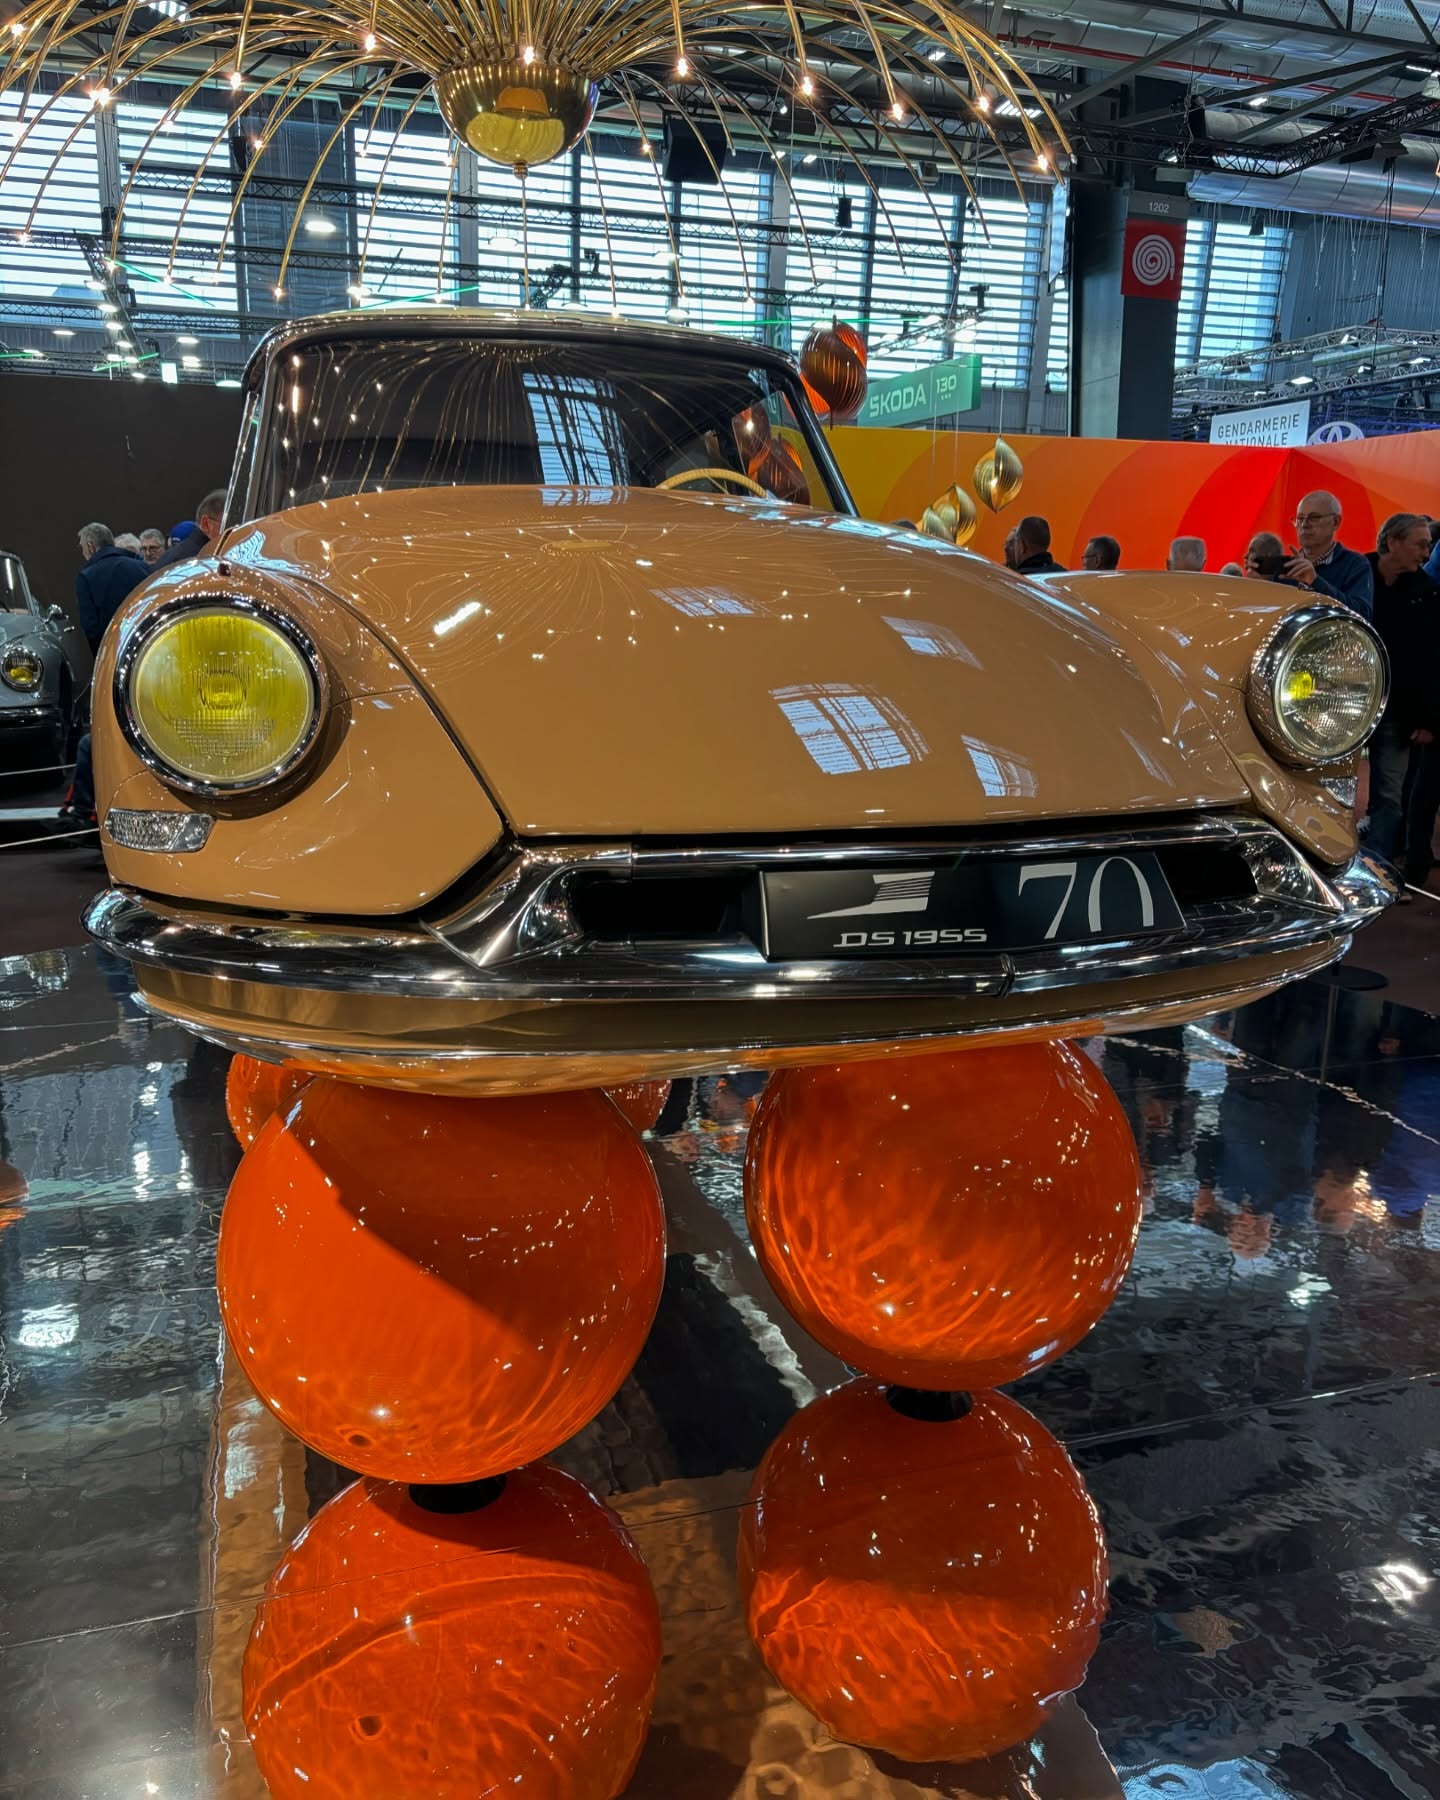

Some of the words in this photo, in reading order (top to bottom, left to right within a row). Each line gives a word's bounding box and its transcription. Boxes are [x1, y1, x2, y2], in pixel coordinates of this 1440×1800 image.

[1149, 202, 1170, 214] 1202
[936, 374, 957, 393] 130
[1217, 414, 1300, 438] GENDARMERIE
[1018, 856, 1154, 939] 70
[833, 931, 895, 948] DS
[903, 928, 988, 945] 1955
